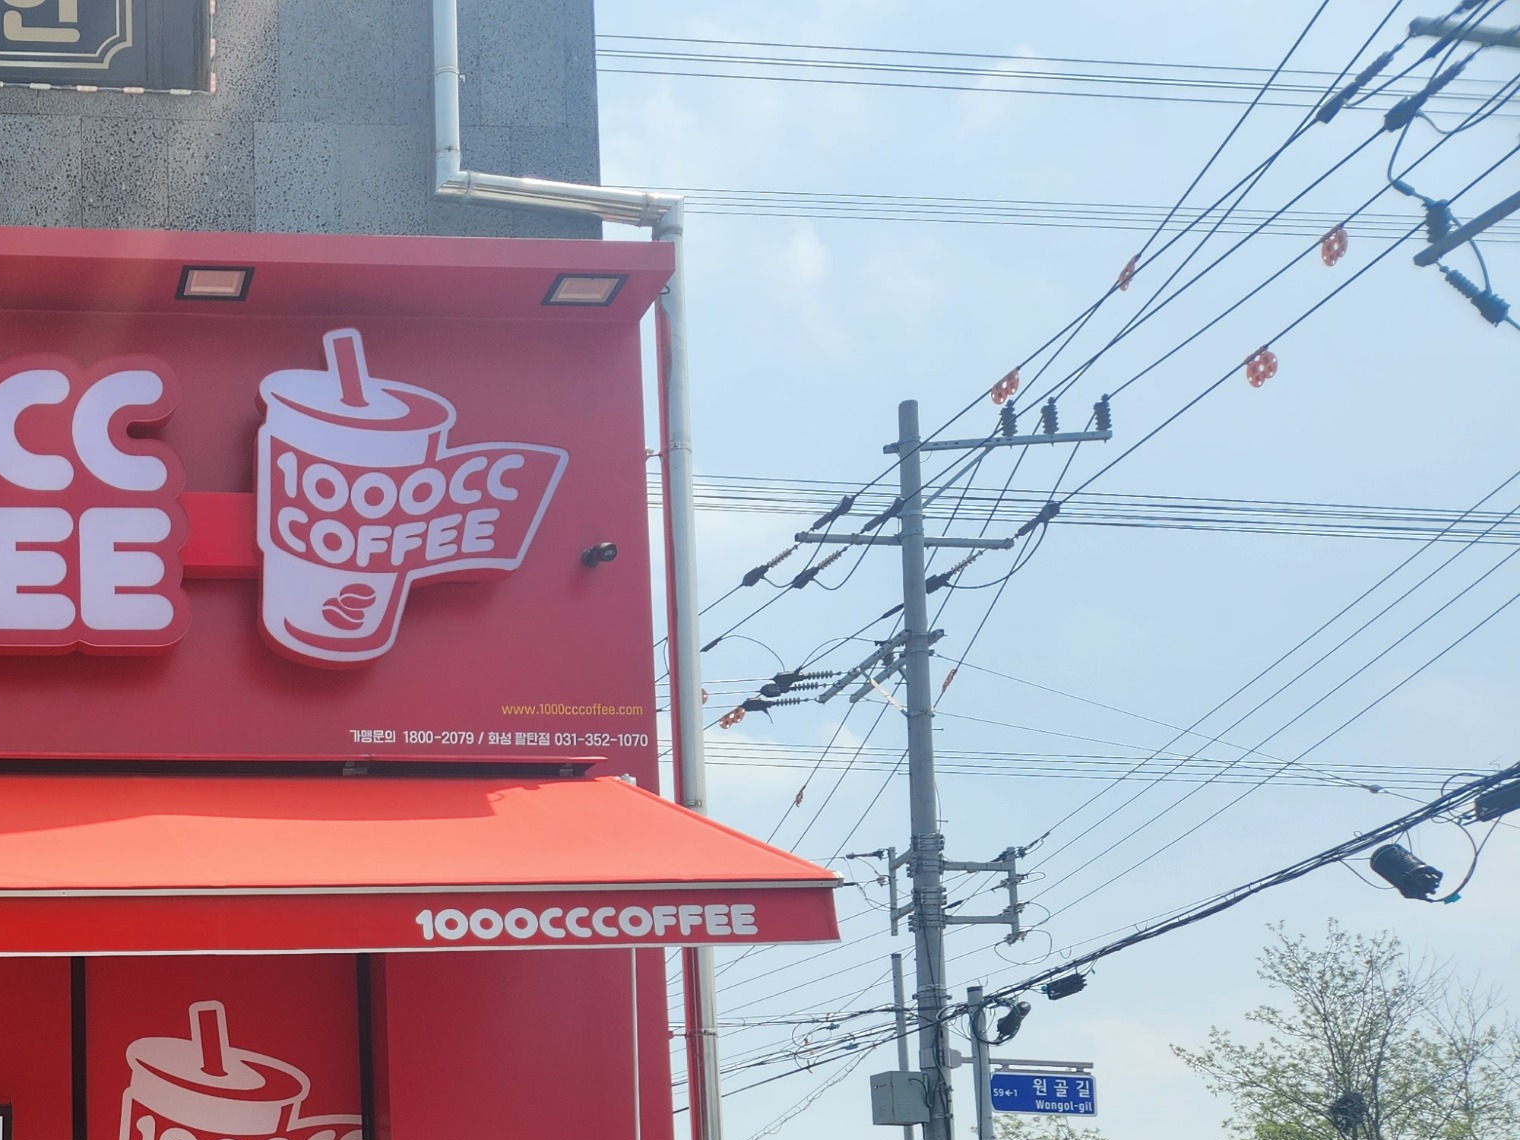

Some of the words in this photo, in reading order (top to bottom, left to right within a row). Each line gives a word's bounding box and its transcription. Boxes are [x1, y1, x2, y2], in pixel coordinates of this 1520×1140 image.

[277, 451, 525, 519] 1000CC
[277, 506, 500, 567] COFFEE
[501, 703, 643, 716] www.1000cccoffee.com
[349, 729, 396, 744] 가맹문의
[403, 731, 474, 745] 1800-2079
[488, 731, 512, 746] 화성
[515, 732, 550, 747] 팔탄점
[555, 733, 648, 747] 031-352-1070
[415, 904, 758, 941] 1000CCCOFFEE
[1033, 1078, 1090, 1098] 원골길
[1035, 1099, 1093, 1113] Wongol-gil
